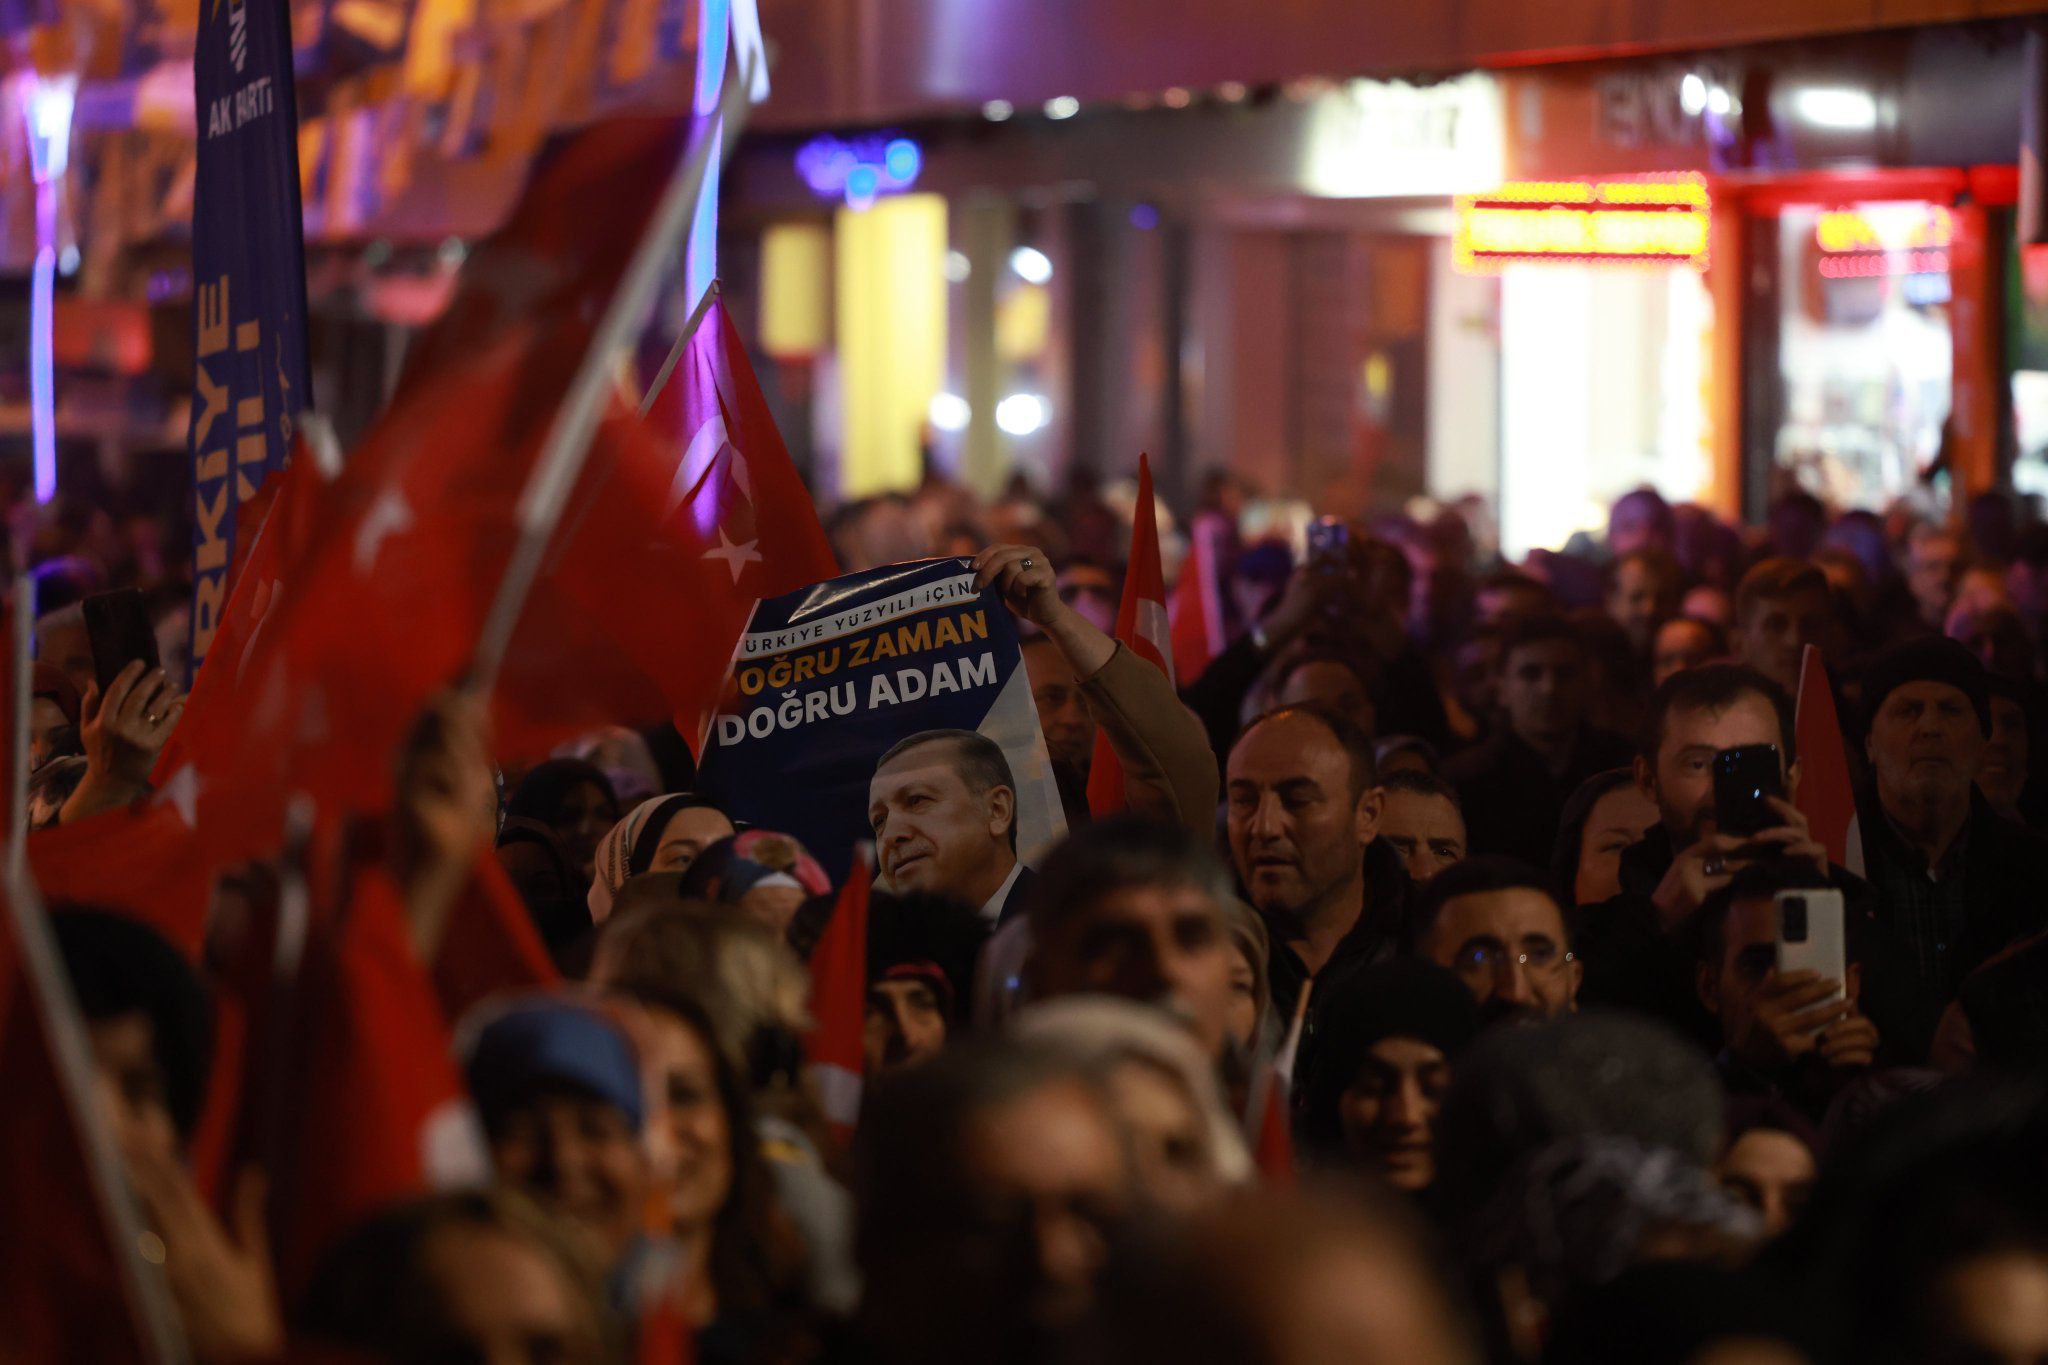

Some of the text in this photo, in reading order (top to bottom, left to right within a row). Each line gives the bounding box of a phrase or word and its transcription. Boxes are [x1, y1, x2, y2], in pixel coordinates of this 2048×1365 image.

[208, 95, 232, 140] AK
[193, 274, 229, 684] RKİYE
[735, 609, 989, 696] OĞRU ZAMAN
[745, 579, 971, 653] ÜRKİYE YÜZYILI İÇİN
[717, 651, 998, 747] DOĞRU ADAM
